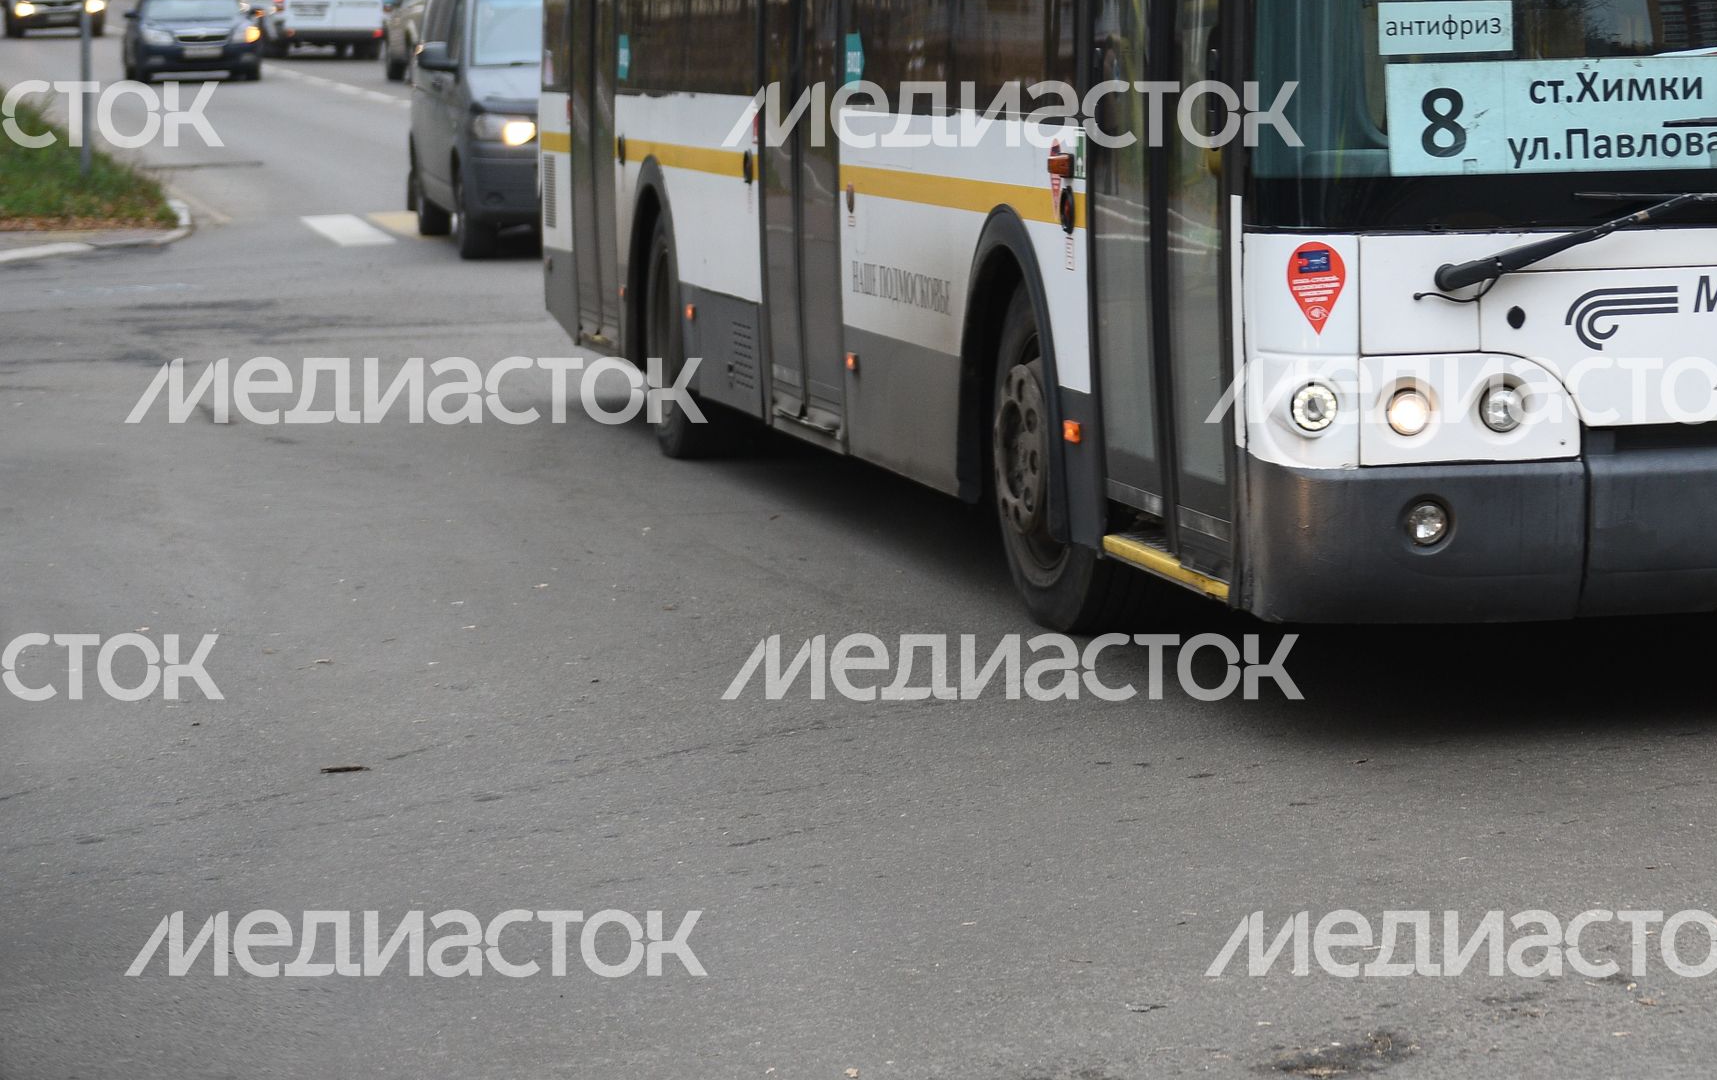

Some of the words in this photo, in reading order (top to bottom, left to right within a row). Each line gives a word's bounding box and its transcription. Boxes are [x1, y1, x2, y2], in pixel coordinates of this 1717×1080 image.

[1385, 14, 1502, 40] антифриз
[1529, 72, 1703, 105] ст.Химки
[1421, 87, 1467, 158] 8
